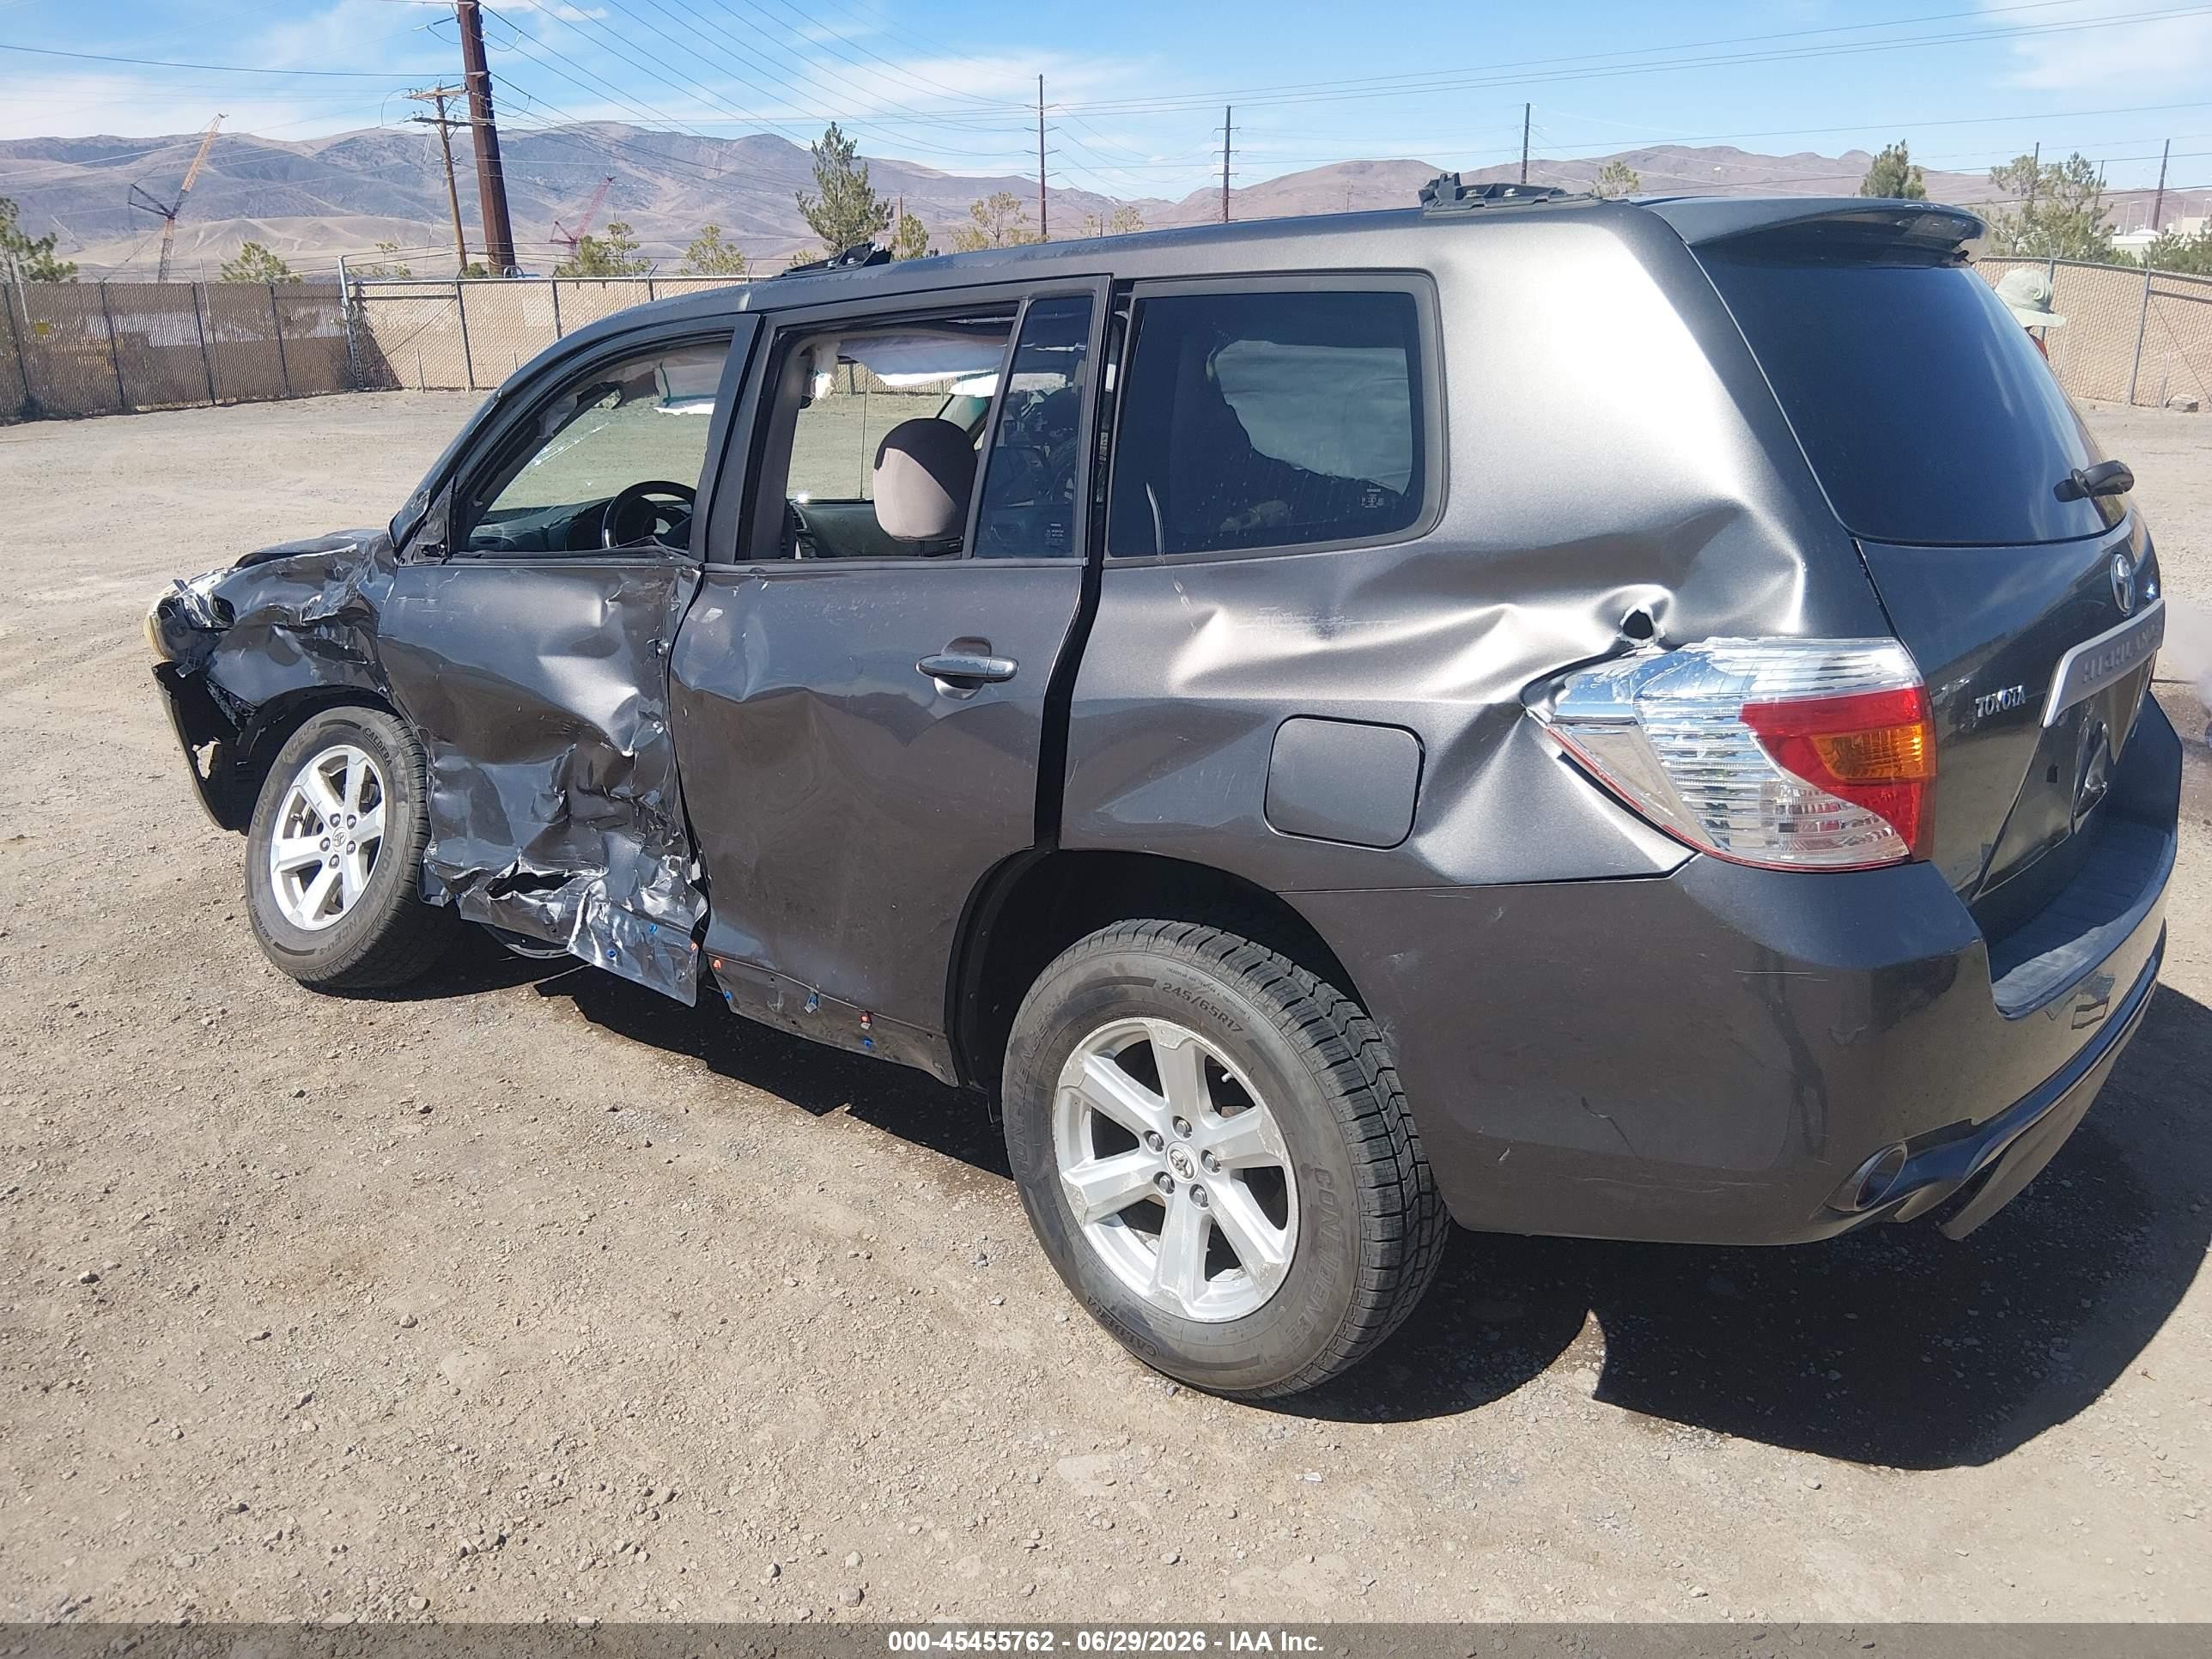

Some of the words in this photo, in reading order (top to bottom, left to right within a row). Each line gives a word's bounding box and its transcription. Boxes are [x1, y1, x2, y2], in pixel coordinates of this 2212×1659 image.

[1975, 685, 2025, 717] TOYOTA
[363, 726, 393, 767] CALDERA
[1162, 981, 1244, 1032] 245/65R17
[1289, 1167, 1342, 1346] CONFIDENCE
[1086, 1296, 1158, 1357] CALDERA
